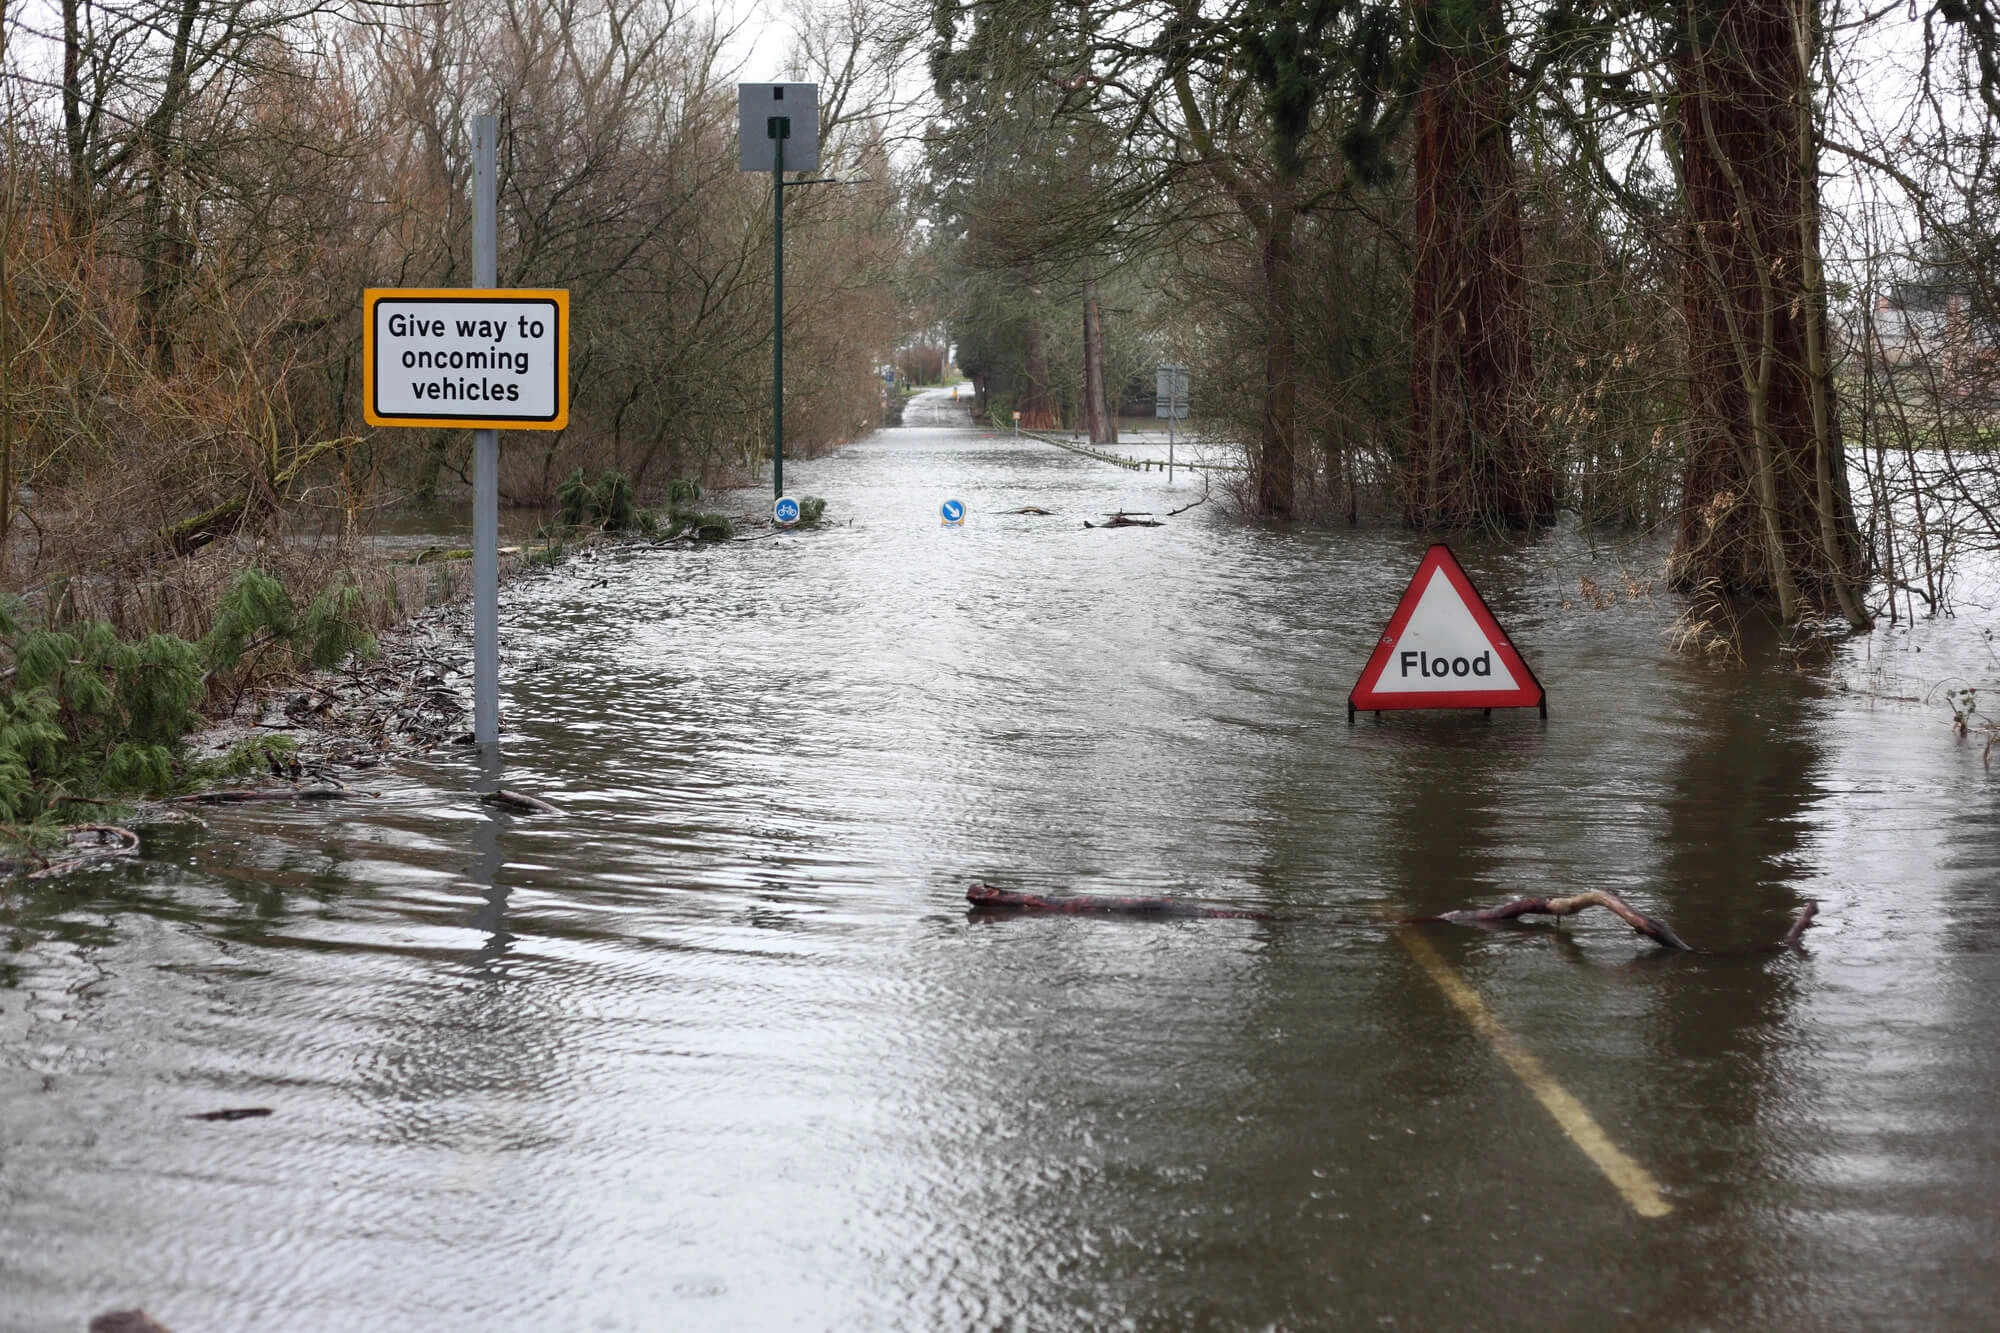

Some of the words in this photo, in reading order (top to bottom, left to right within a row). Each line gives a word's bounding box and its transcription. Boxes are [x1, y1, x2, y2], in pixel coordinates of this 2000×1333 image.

[388, 313, 445, 337] Give
[456, 319, 507, 342] way
[518, 315, 544, 338] to
[402, 346, 529, 374] oncoming
[412, 377, 519, 401] vehicles
[1400, 650, 1491, 678] Flood
